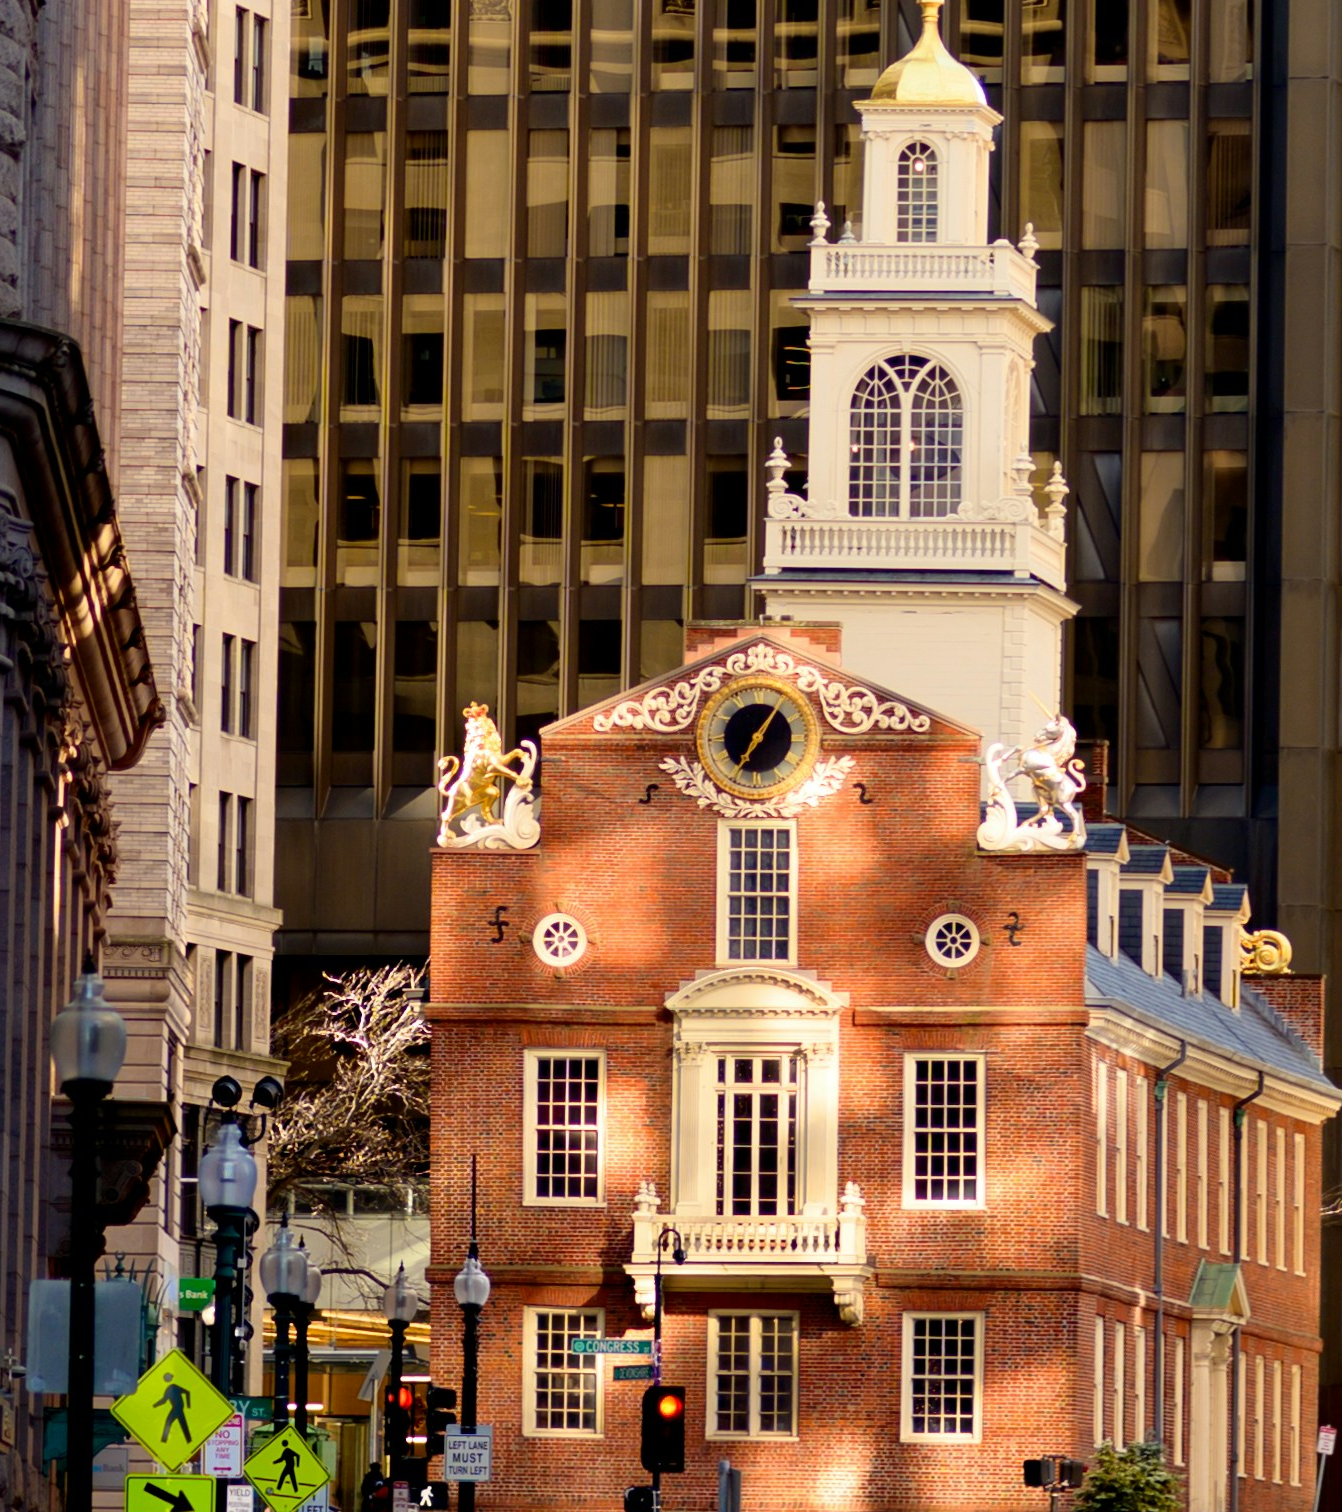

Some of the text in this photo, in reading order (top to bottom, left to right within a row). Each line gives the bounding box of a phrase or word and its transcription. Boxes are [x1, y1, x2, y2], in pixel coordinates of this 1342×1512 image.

[185, 1289, 208, 1299] Bank
[585, 1340, 640, 1353] CONGRESS
[216, 1430, 230, 1439] NO
[448, 1440, 488, 1450] LEFT LANE
[452, 1453, 483, 1463] MUST
[448, 1466, 487, 1475] TURN LEFT
[229, 1488, 251, 1497] YIELD
